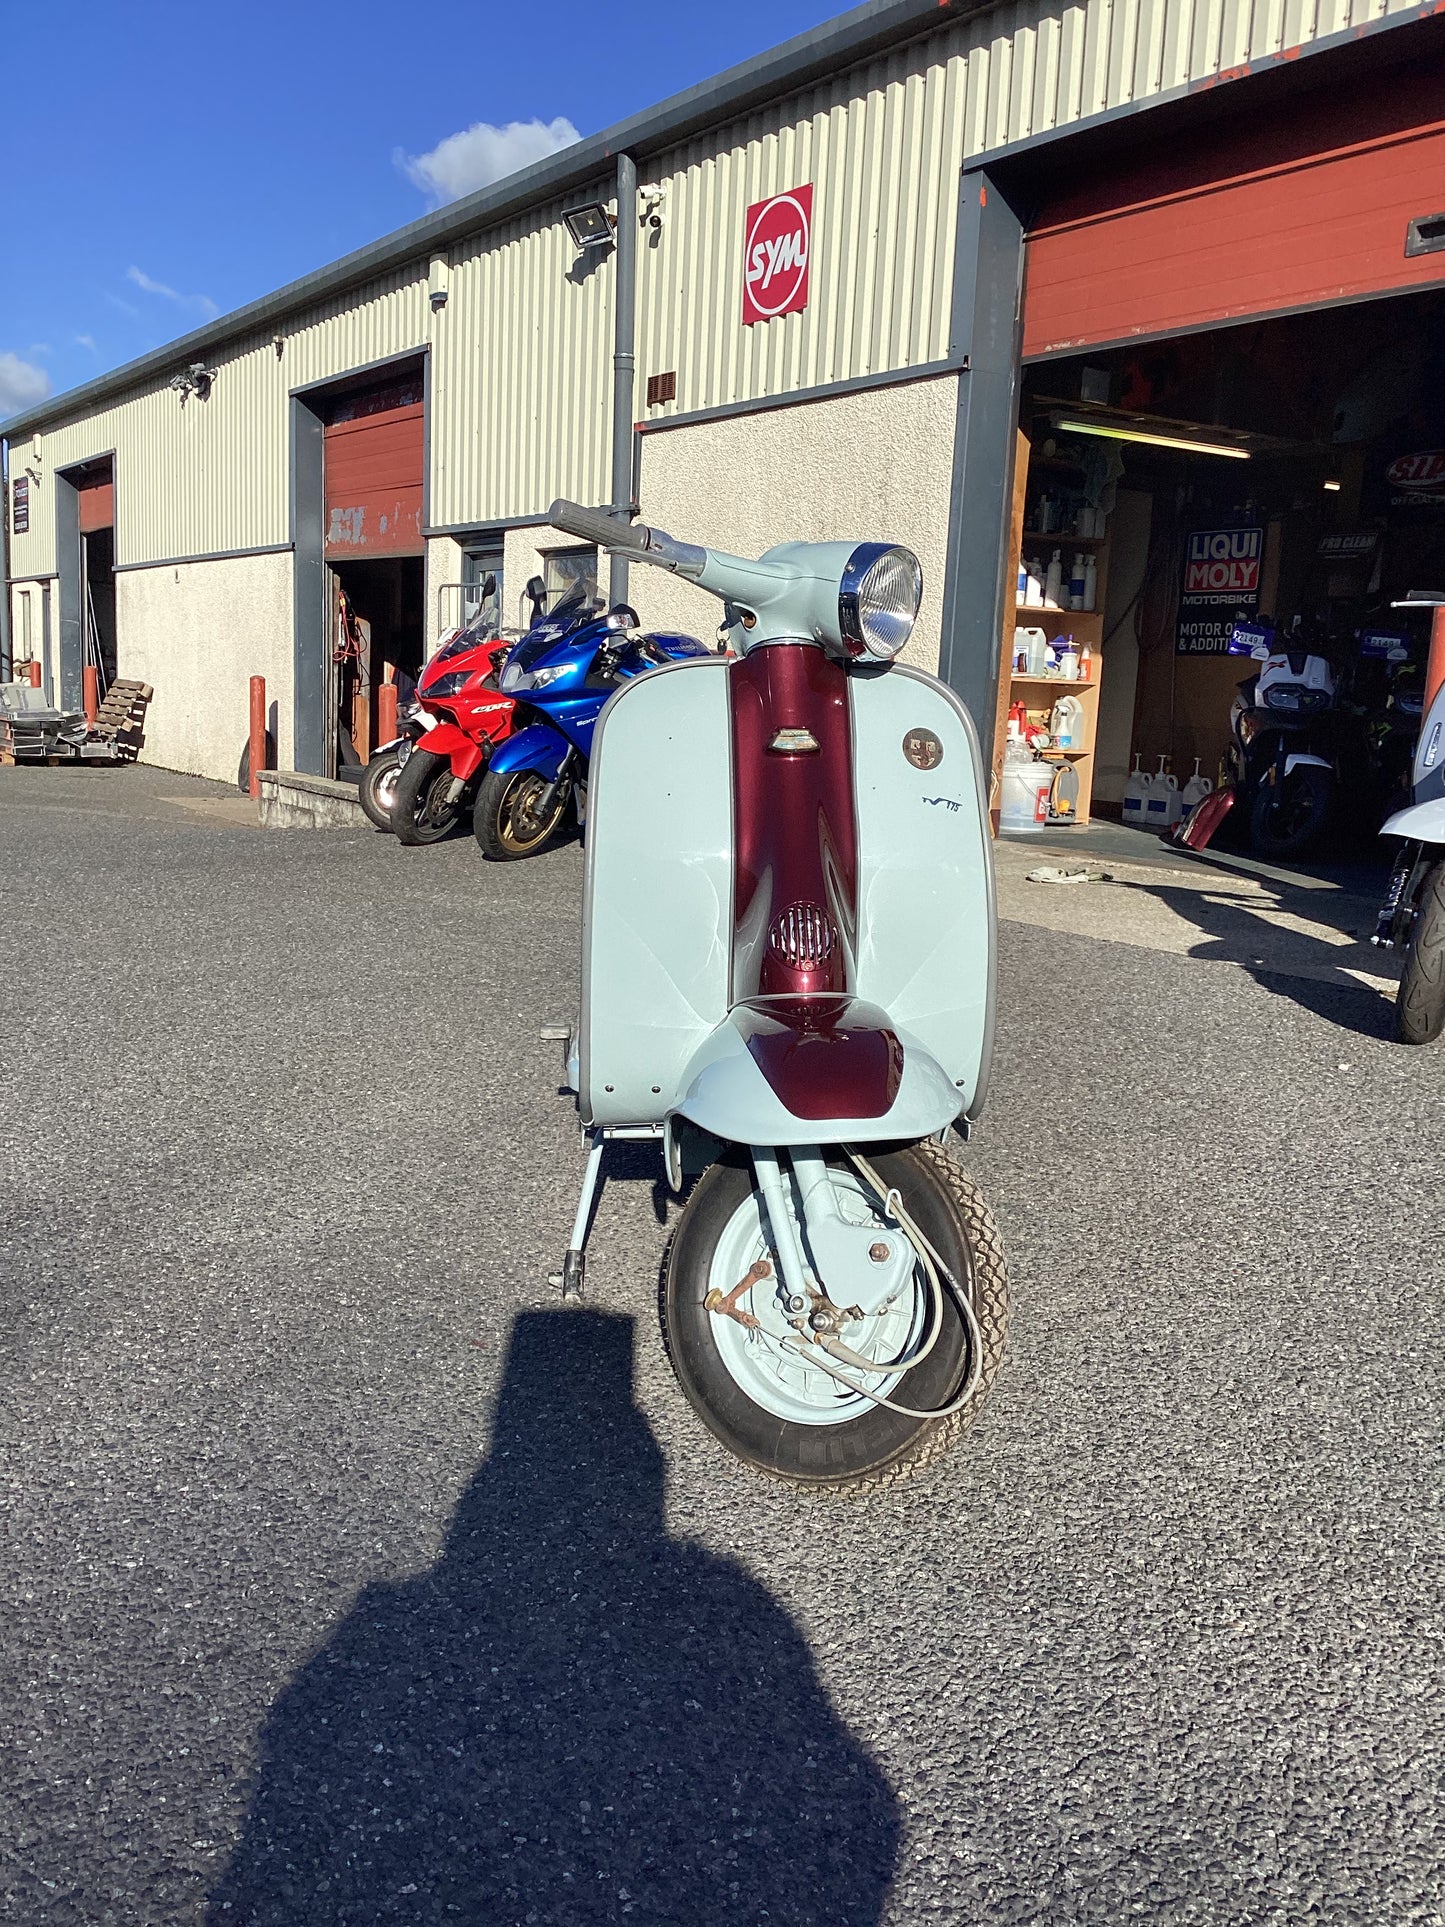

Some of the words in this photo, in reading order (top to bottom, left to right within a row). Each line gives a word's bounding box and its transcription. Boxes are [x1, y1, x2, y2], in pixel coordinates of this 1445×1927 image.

[747, 229, 806, 289] SYM
[1191, 532, 1258, 560] LIQUI
[1189, 562, 1257, 589] MOLY
[1182, 594, 1257, 605] MOTORBIKE
[1180, 622, 1221, 636] MOTOR
[1178, 638, 1188, 651] &
[1189, 637, 1231, 651] ADDITI
